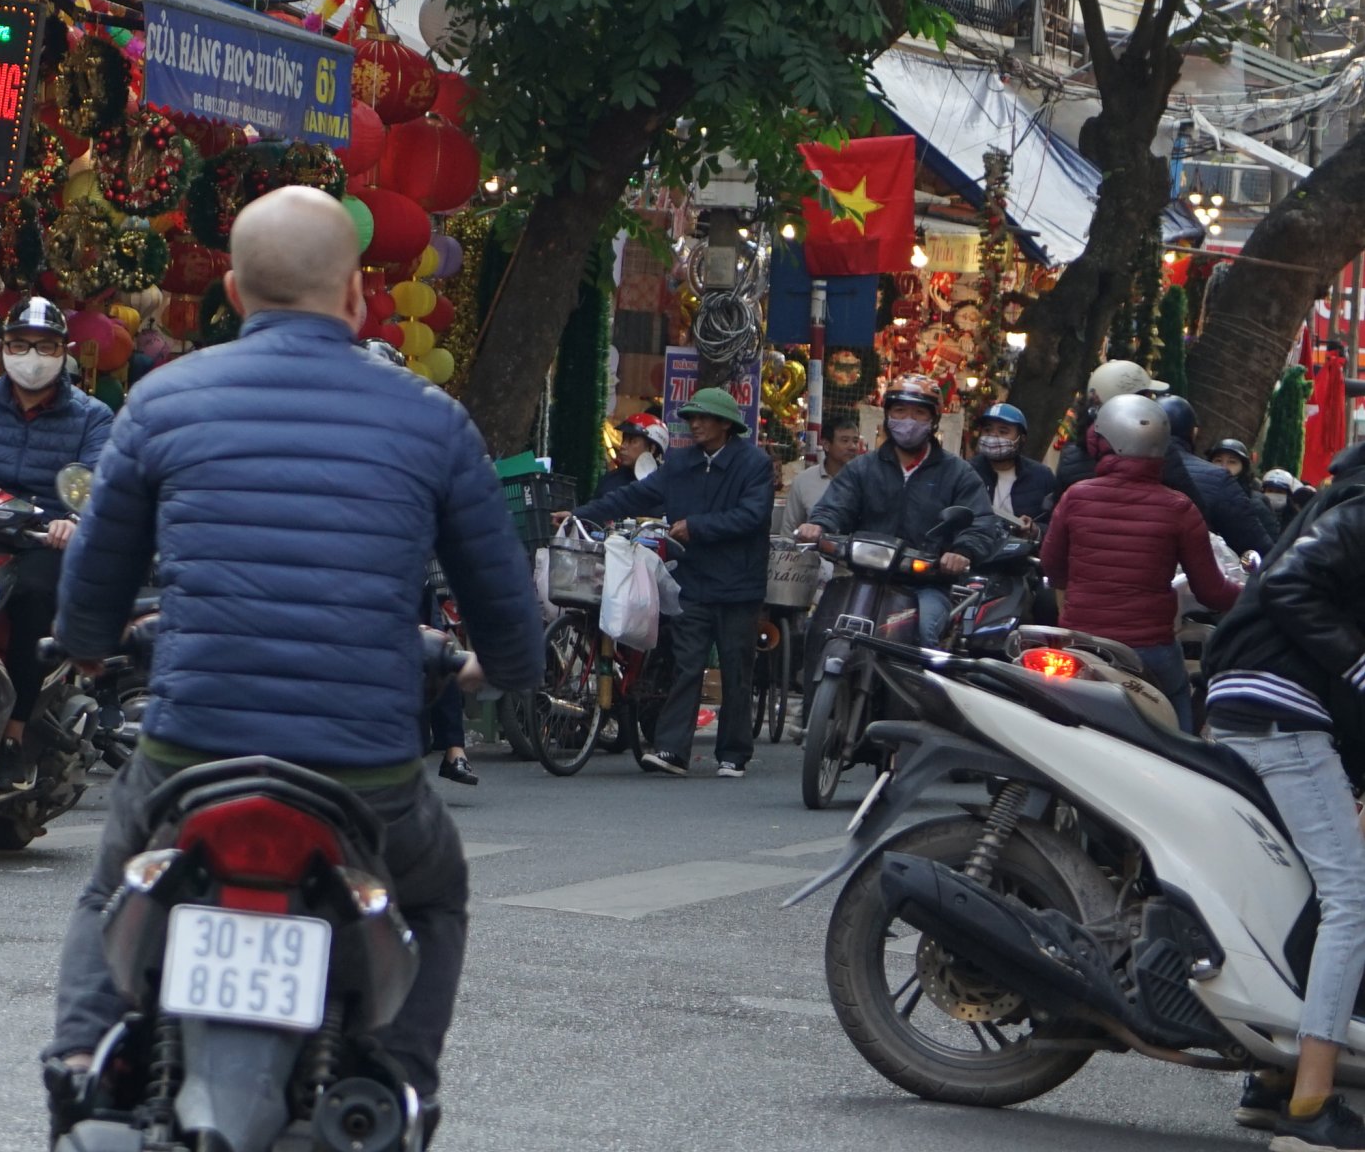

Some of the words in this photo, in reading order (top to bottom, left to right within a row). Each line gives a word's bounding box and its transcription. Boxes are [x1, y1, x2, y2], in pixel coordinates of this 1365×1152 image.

[145, 9, 176, 68] CỬA
[179, 23, 222, 79] HÀNG
[222, 42, 255, 94] HỌC
[315, 56, 337, 105] 65
[327, 109, 350, 140] MÃ
[671, 377, 686, 402] 71
[193, 913, 305, 968] 30-K9
[187, 963, 300, 1017] 8653
